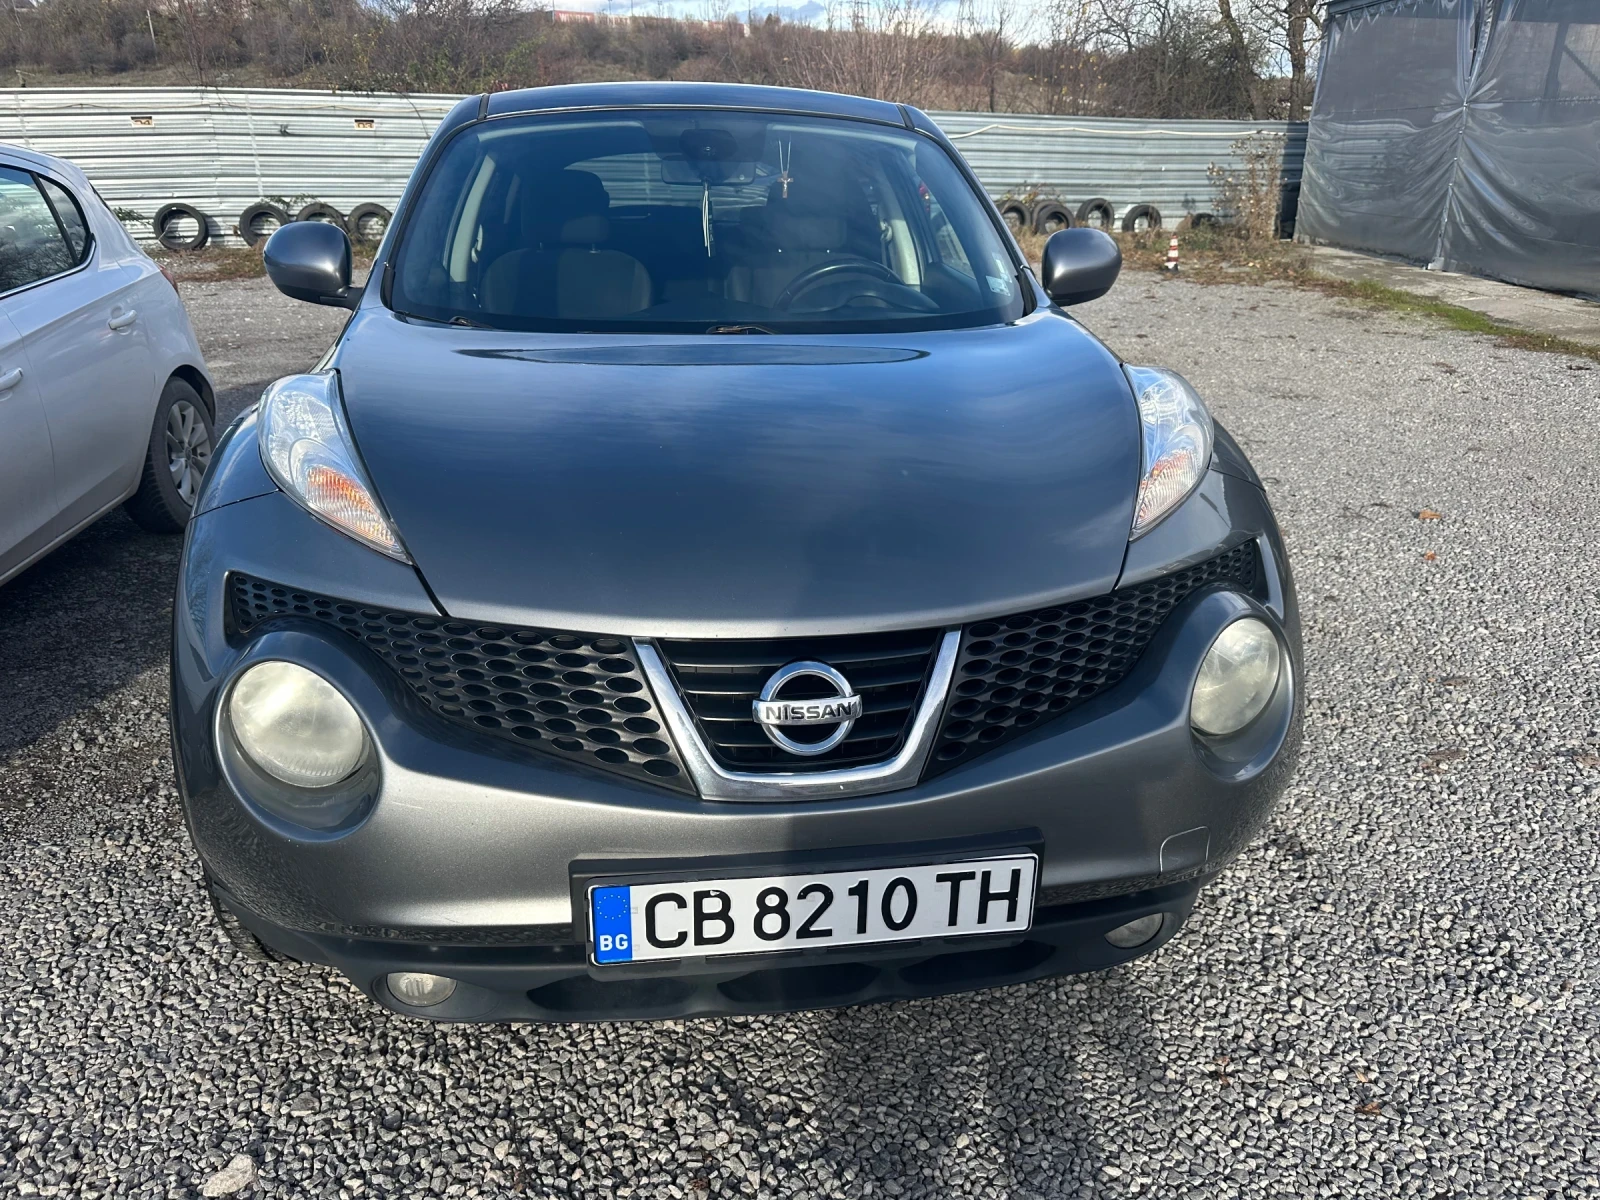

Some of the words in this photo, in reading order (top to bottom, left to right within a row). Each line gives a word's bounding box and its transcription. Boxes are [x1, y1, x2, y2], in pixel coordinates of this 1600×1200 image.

[765, 702, 852, 720] NISSAN
[645, 890, 735, 949] CB
[753, 876, 918, 941] 8210
[936, 868, 1021, 927] TH
[600, 934, 628, 951] BG
